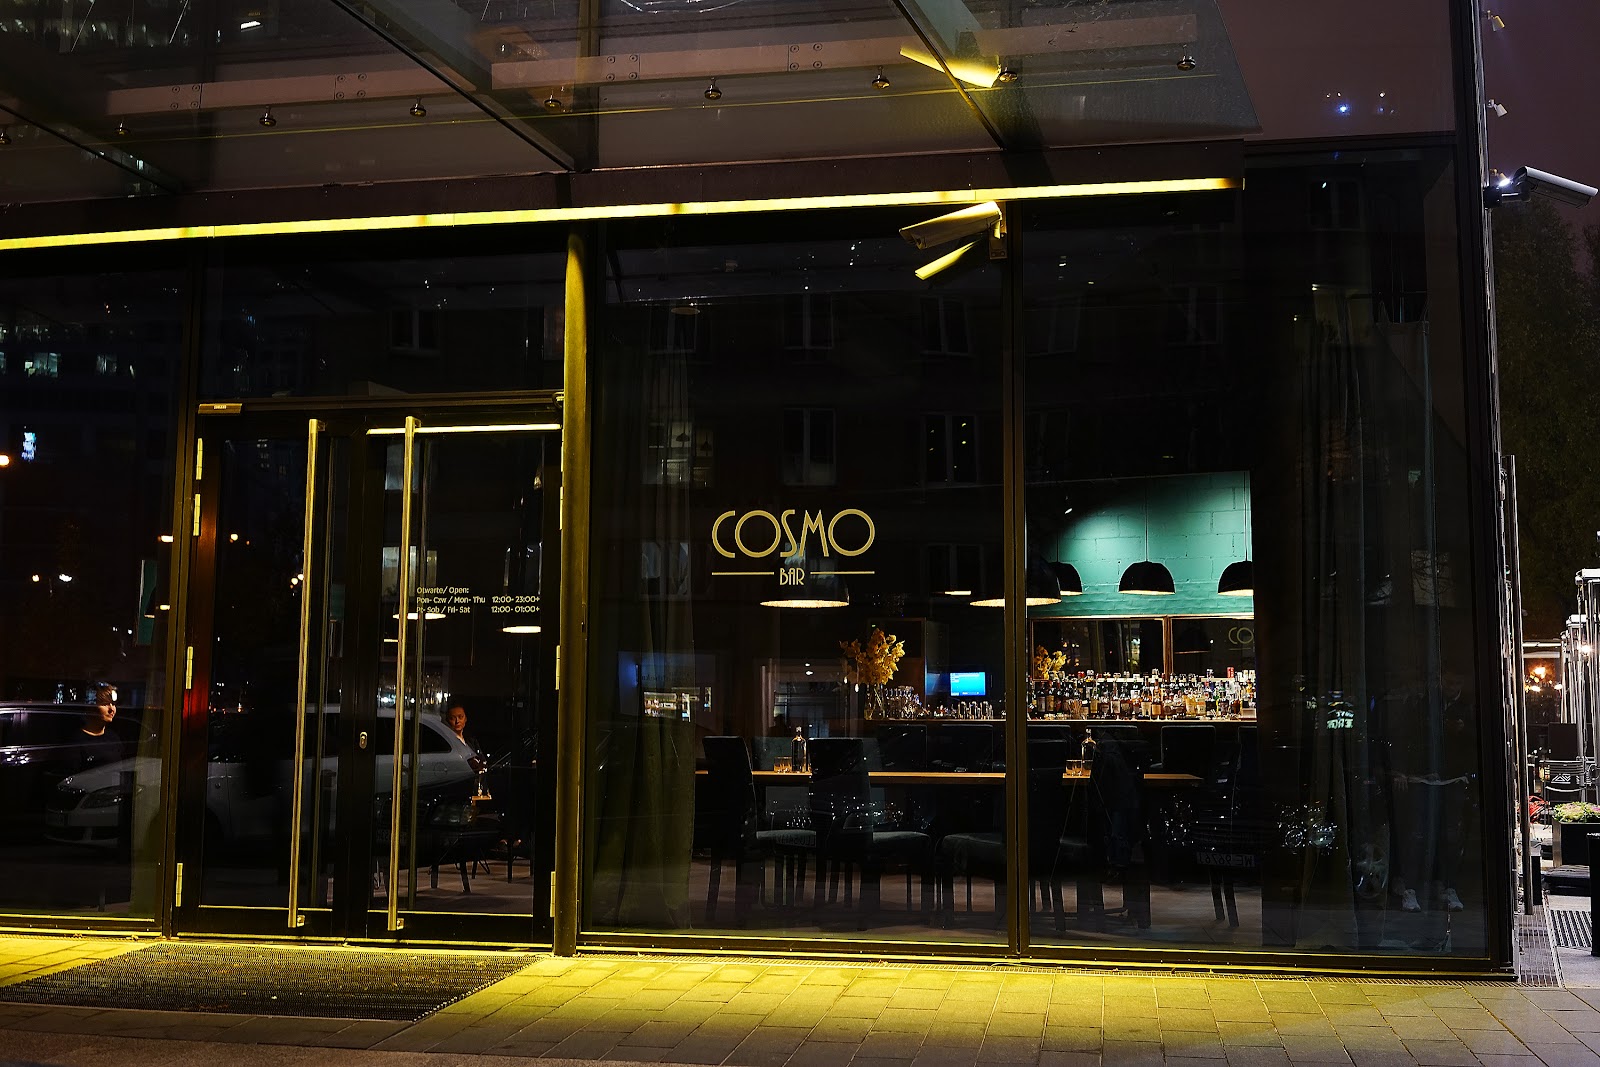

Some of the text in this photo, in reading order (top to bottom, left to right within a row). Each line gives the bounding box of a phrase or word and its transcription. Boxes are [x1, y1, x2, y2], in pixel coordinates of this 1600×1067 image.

[711, 508, 875, 558] COSMO
[779, 566, 805, 586] BAR
[459, 605, 471, 613] Sat
